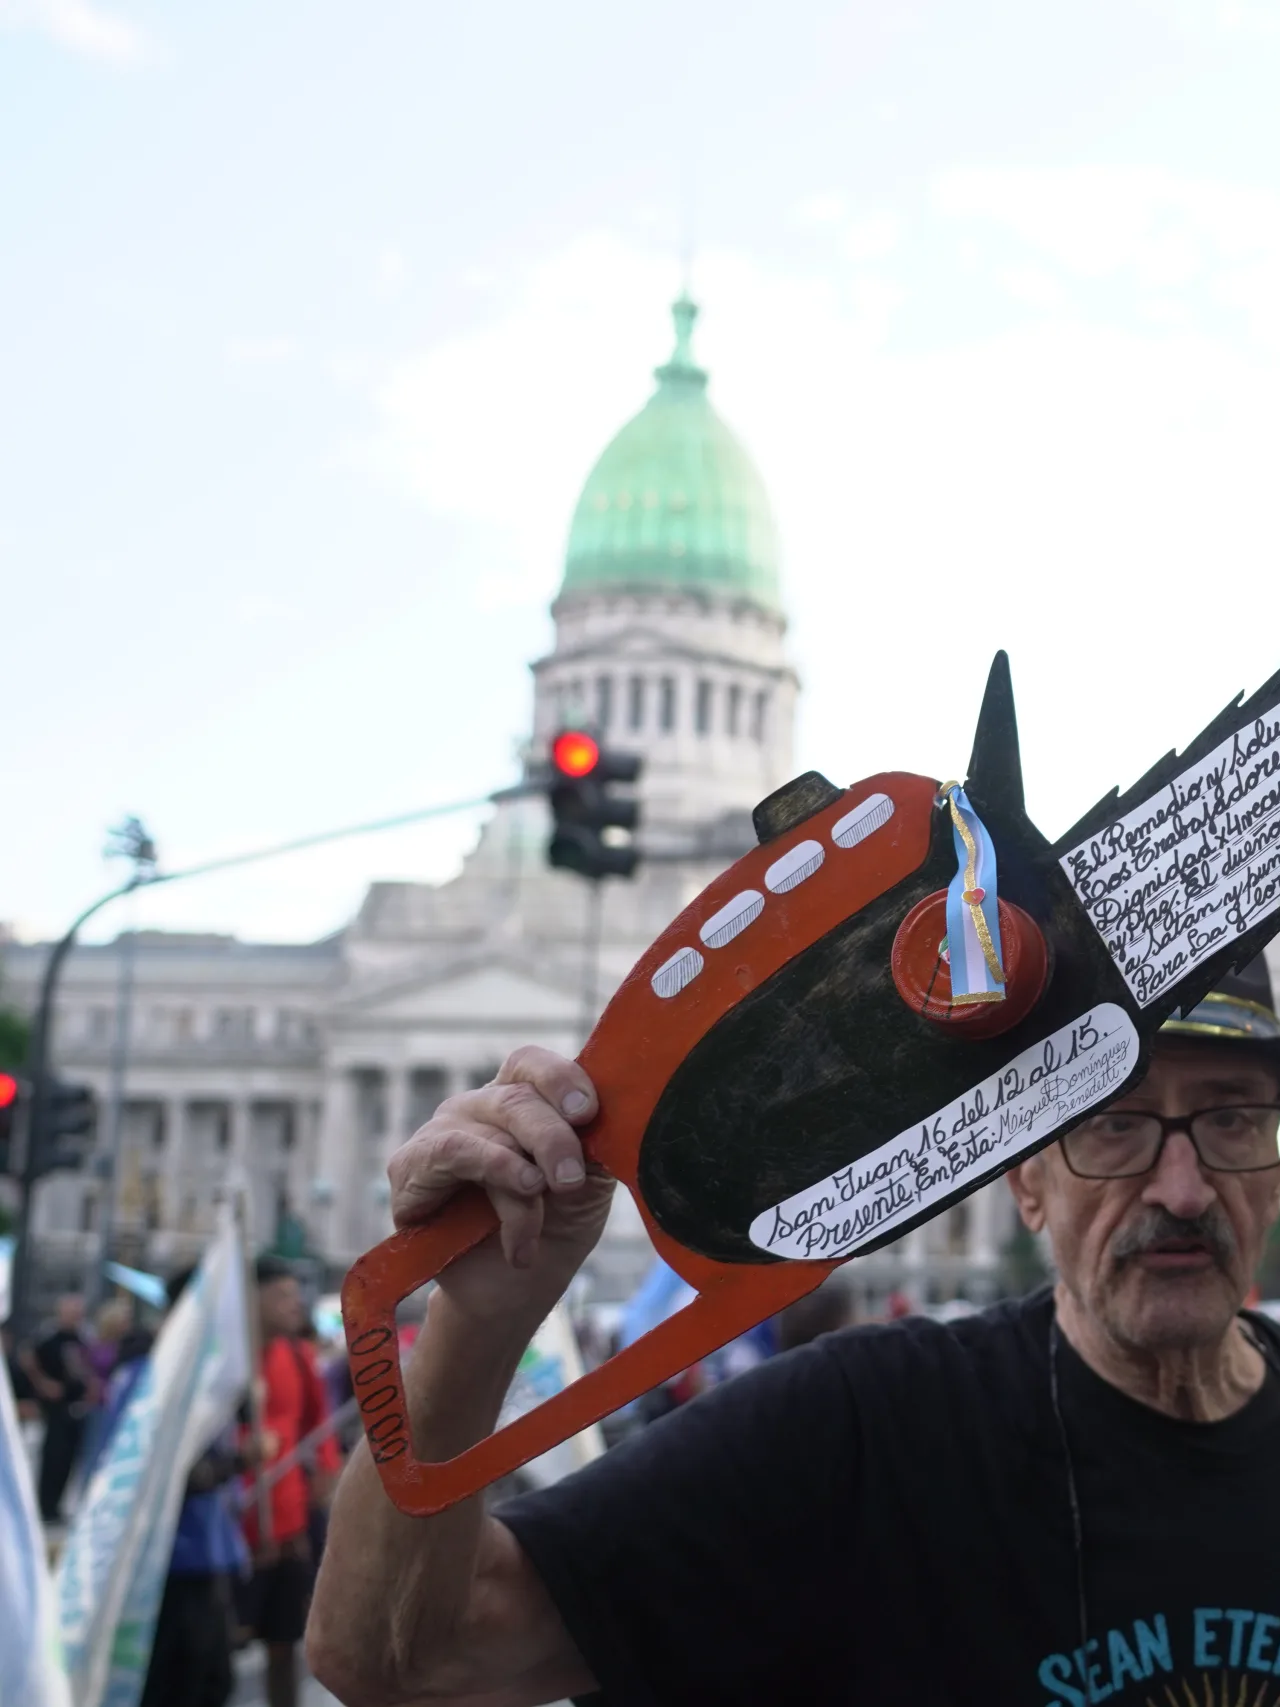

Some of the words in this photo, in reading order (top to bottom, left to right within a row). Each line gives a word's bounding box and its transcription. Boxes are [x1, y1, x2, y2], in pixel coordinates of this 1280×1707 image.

[1067, 841, 1111, 890] El
[1101, 776, 1204, 860] Remedio
[1206, 758, 1229, 803] y
[1080, 861, 1131, 912] Los
[1090, 829, 1217, 932] Dignidad
[1105, 930, 1126, 963] y
[1180, 860, 1218, 909] El
[1124, 957, 1143, 976] a
[1223, 881, 1243, 910] y
[1131, 952, 1188, 1002] Para
[1187, 925, 1227, 957] La
[767, 1197, 835, 1247] San
[832, 1149, 914, 1203] Juan
[916, 1117, 949, 1158] 16
[951, 1089, 991, 1136] del
[993, 1067, 1028, 1111] 12
[1029, 1039, 1063, 1087] al
[909, 1157, 950, 1202] En
[998, 1079, 1056, 1143] Miguel
[1038, 1613, 1174, 1707] SEAN
